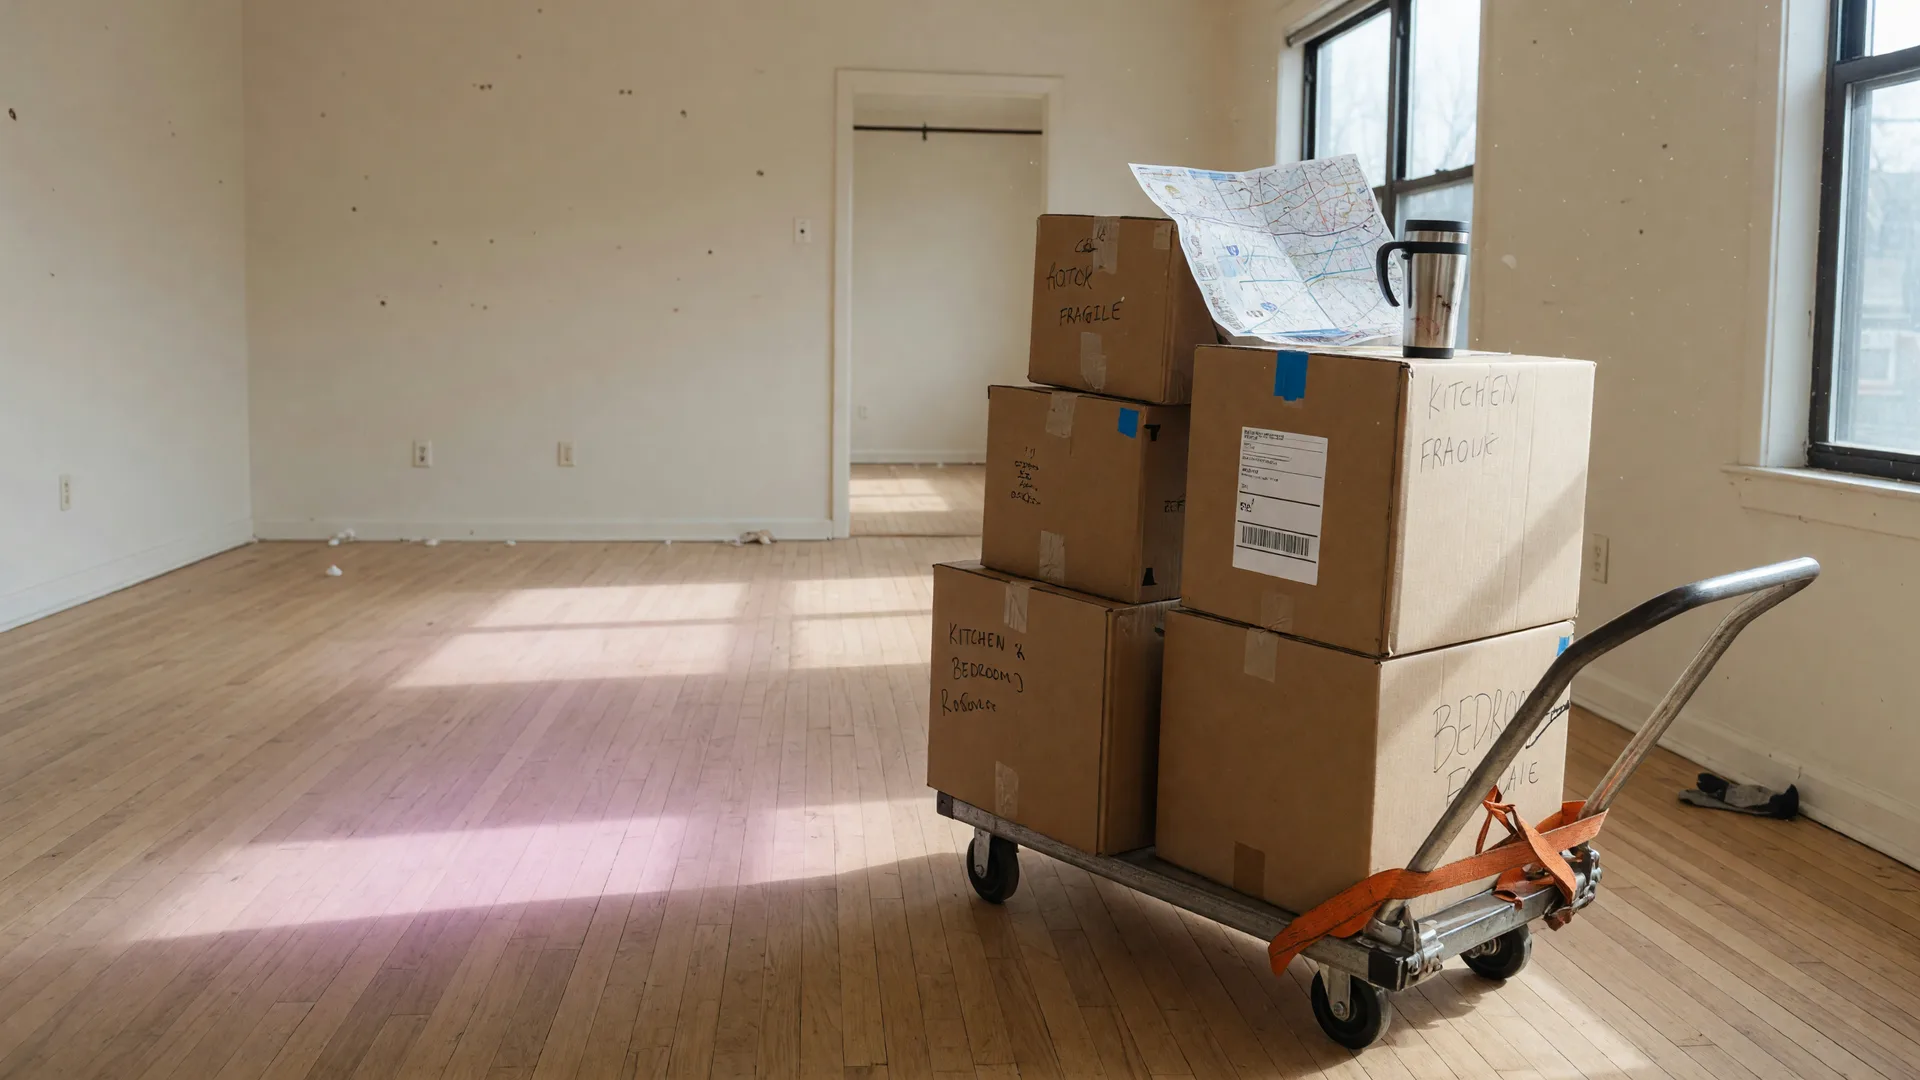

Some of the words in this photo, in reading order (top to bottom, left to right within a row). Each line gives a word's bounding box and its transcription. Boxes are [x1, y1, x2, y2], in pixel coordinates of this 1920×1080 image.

[1059, 300, 1123, 326] FRAGILE
[1428, 372, 1521, 419] KITCHEN
[949, 622, 1005, 651] KITCHEN
